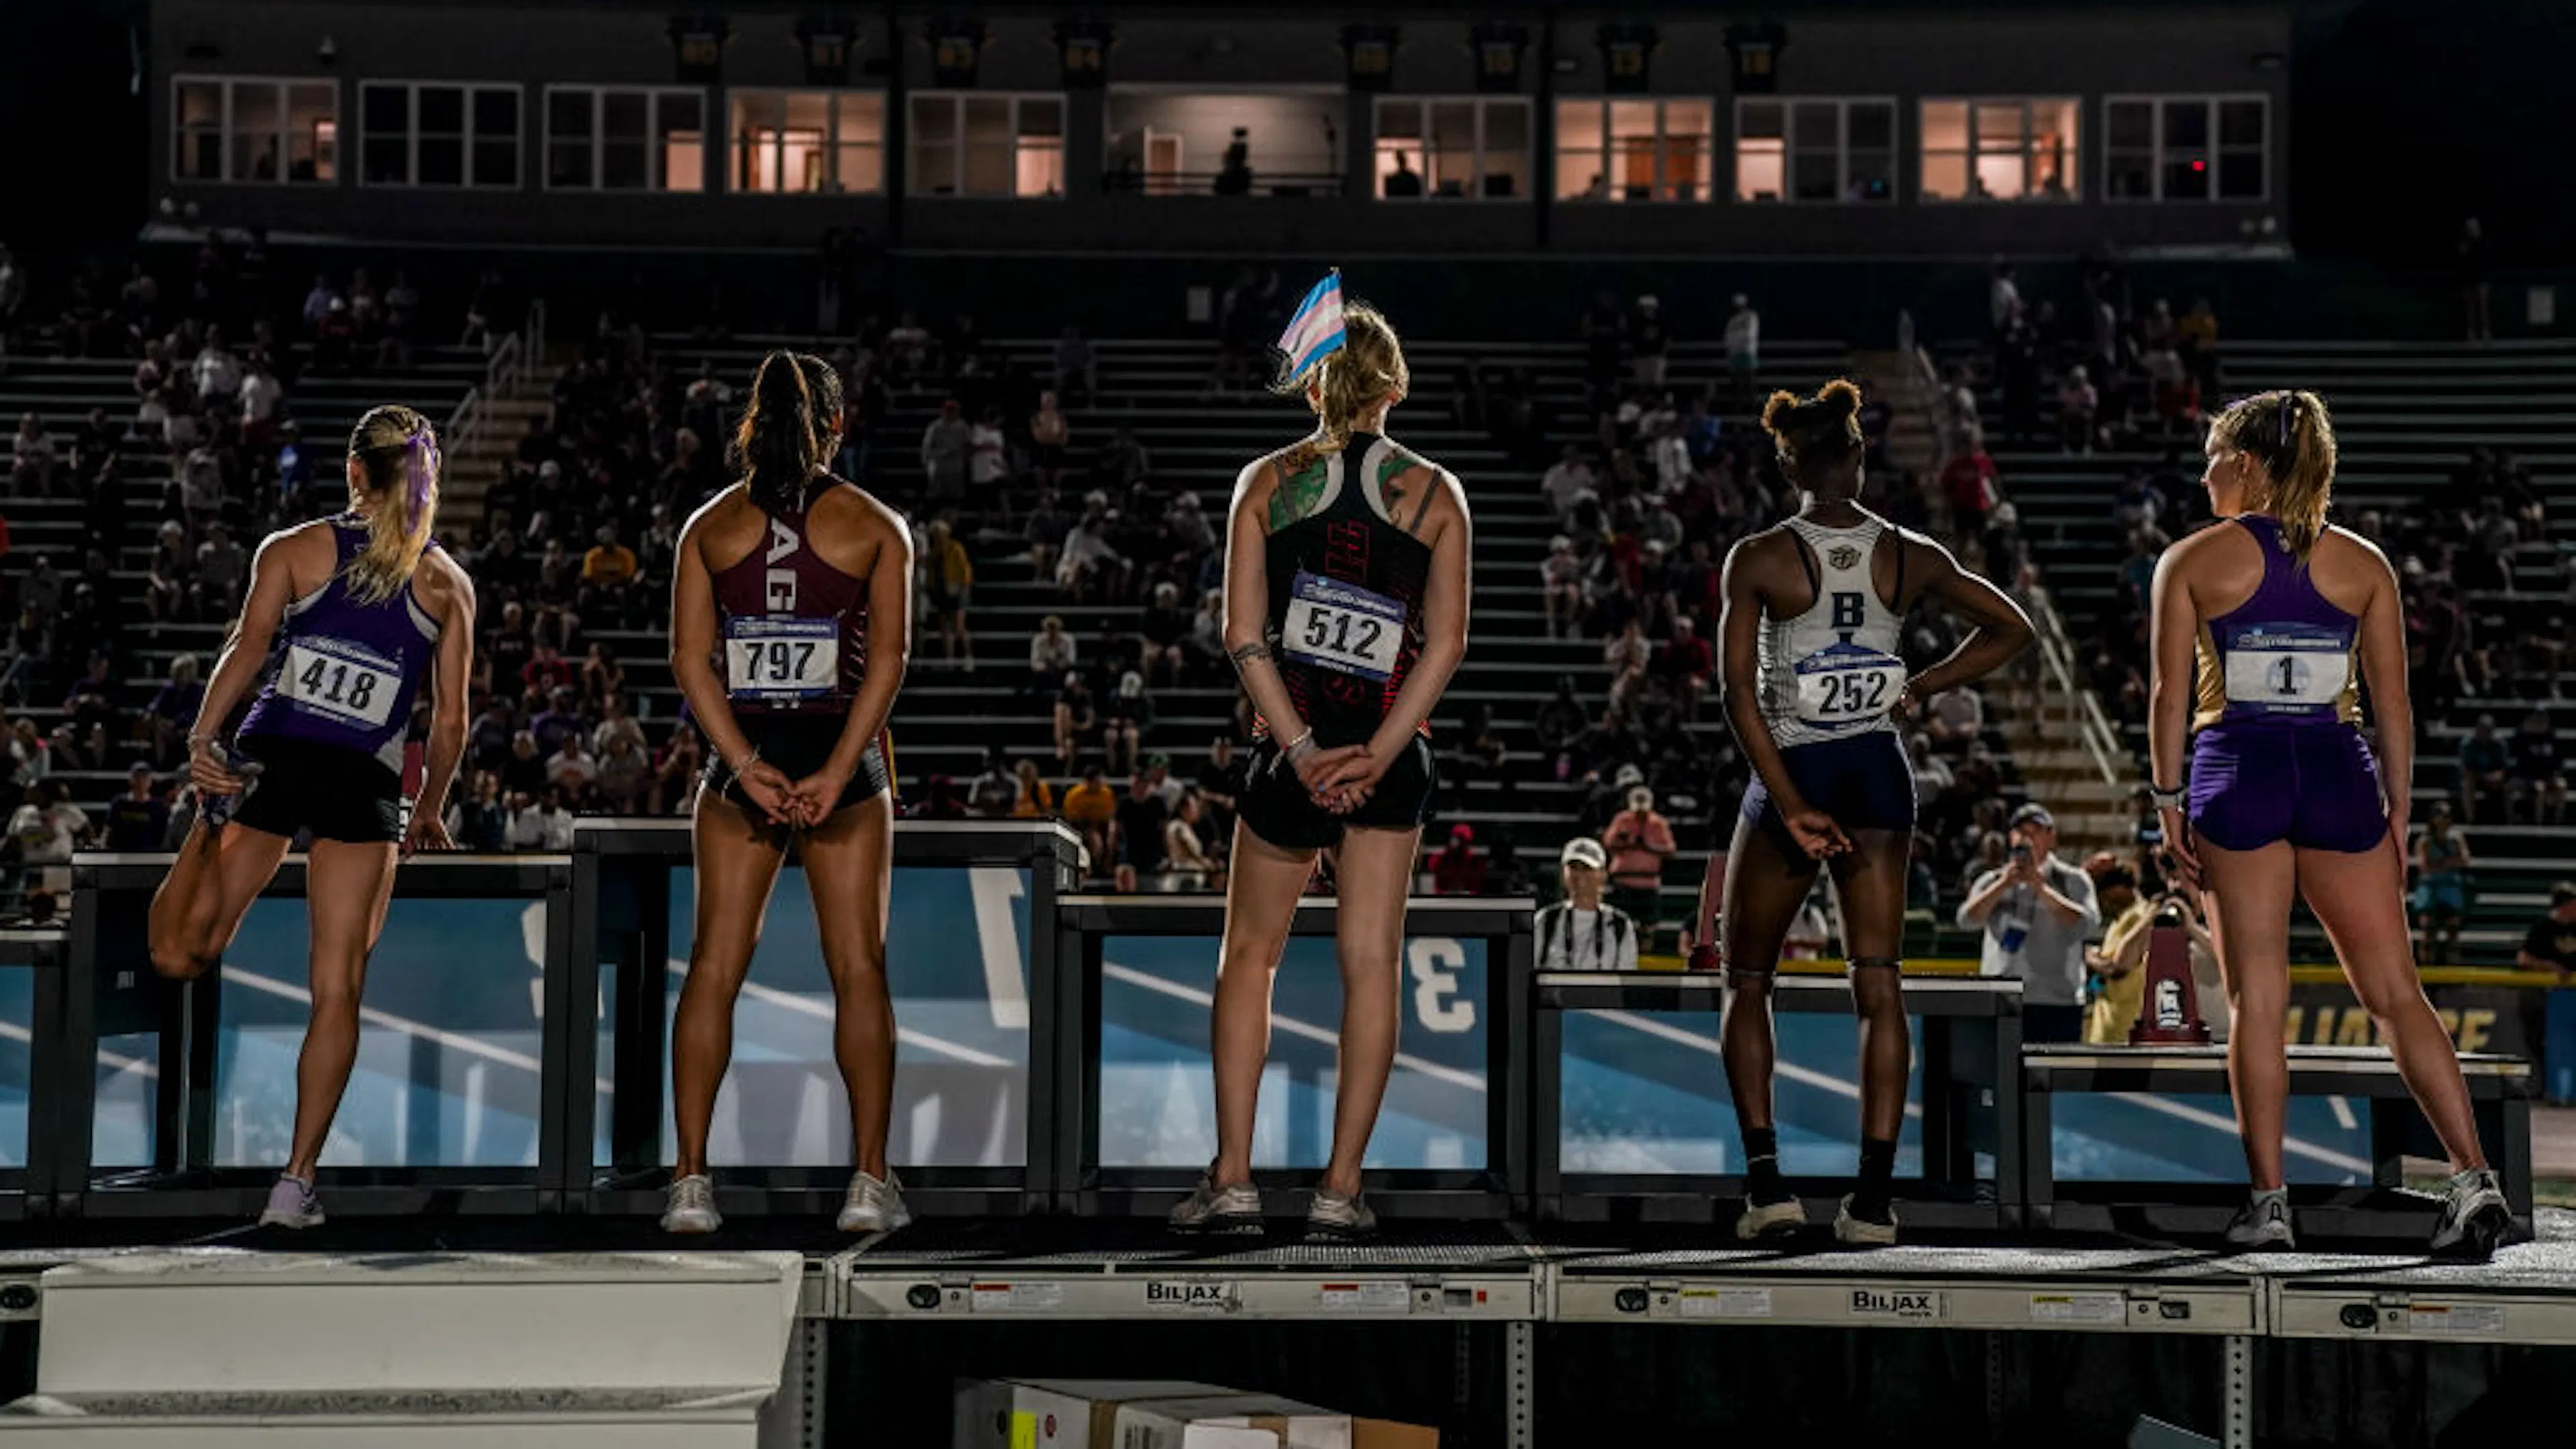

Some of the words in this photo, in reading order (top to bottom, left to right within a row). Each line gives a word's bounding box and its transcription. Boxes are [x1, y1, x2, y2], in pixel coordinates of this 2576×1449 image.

[766, 517, 799, 621] AG
[1305, 607, 1382, 660] 512
[300, 657, 377, 710] 418
[745, 642, 815, 680] 797
[2279, 655, 2297, 695] 1
[1819, 672, 1887, 714] 252
